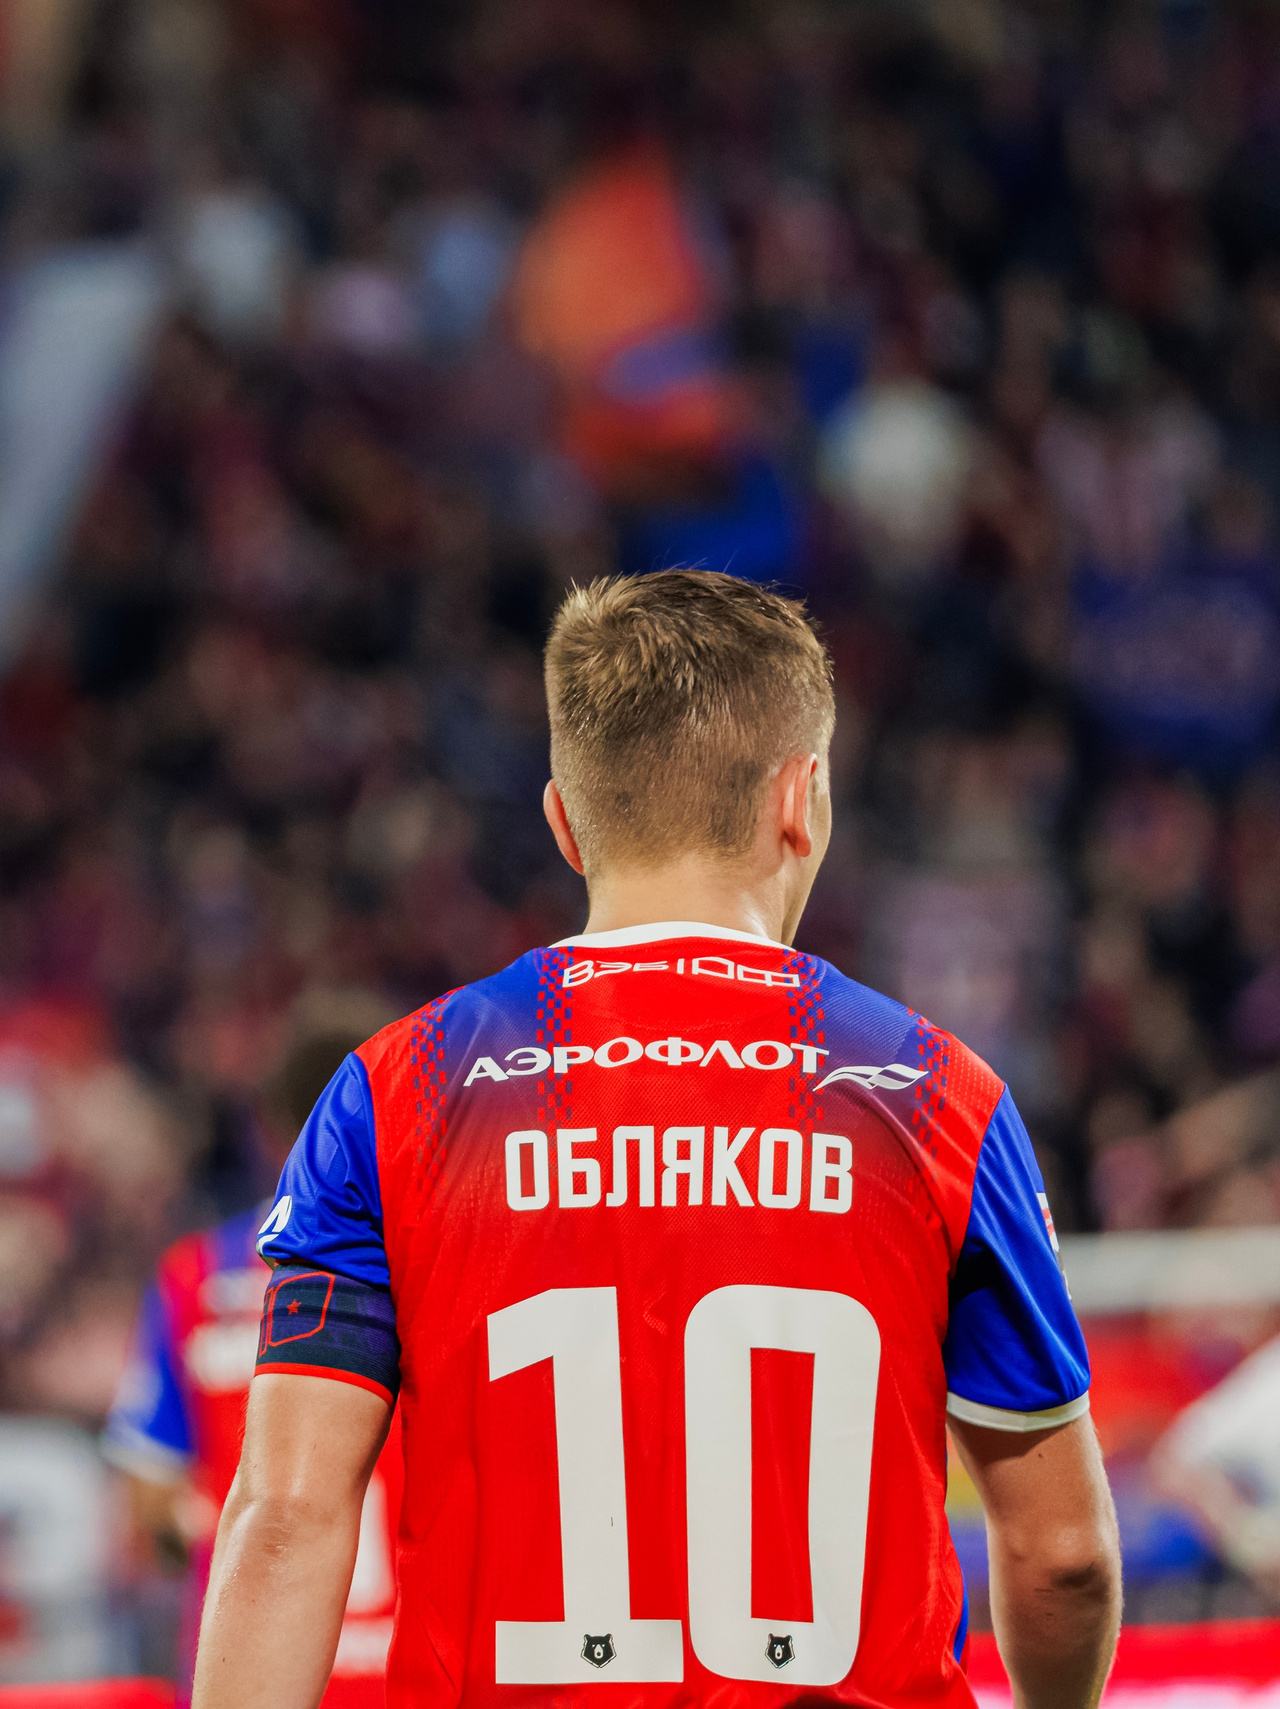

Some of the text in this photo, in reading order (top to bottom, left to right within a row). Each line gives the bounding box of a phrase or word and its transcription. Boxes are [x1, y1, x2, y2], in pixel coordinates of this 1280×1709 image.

[463, 1036, 830, 1087] АЭРОФЛОТ
[504, 1125, 853, 1213] ОБЛЯКОВ
[486, 1284, 881, 1686] 10
